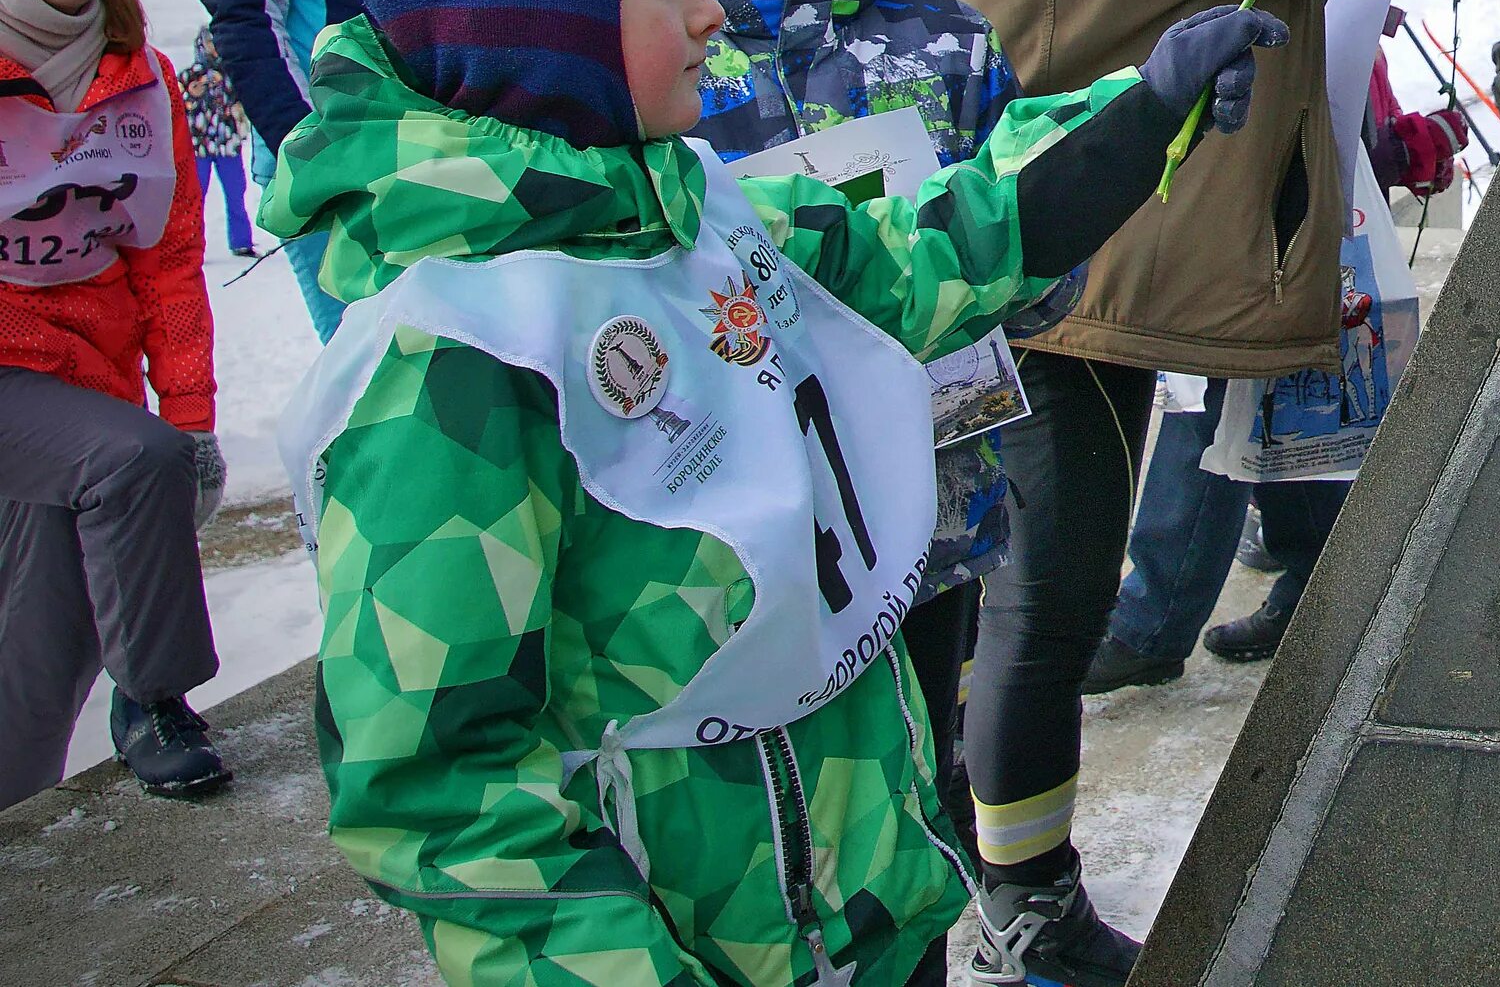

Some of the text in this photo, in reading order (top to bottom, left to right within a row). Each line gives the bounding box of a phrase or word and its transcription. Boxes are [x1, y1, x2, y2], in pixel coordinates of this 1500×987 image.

[121, 123, 147, 139] 180
[757, 369, 783, 392] Я
[666, 425, 728, 495] БОРОДИНСКОЕ
[695, 453, 723, 484] ПОЛЕ
